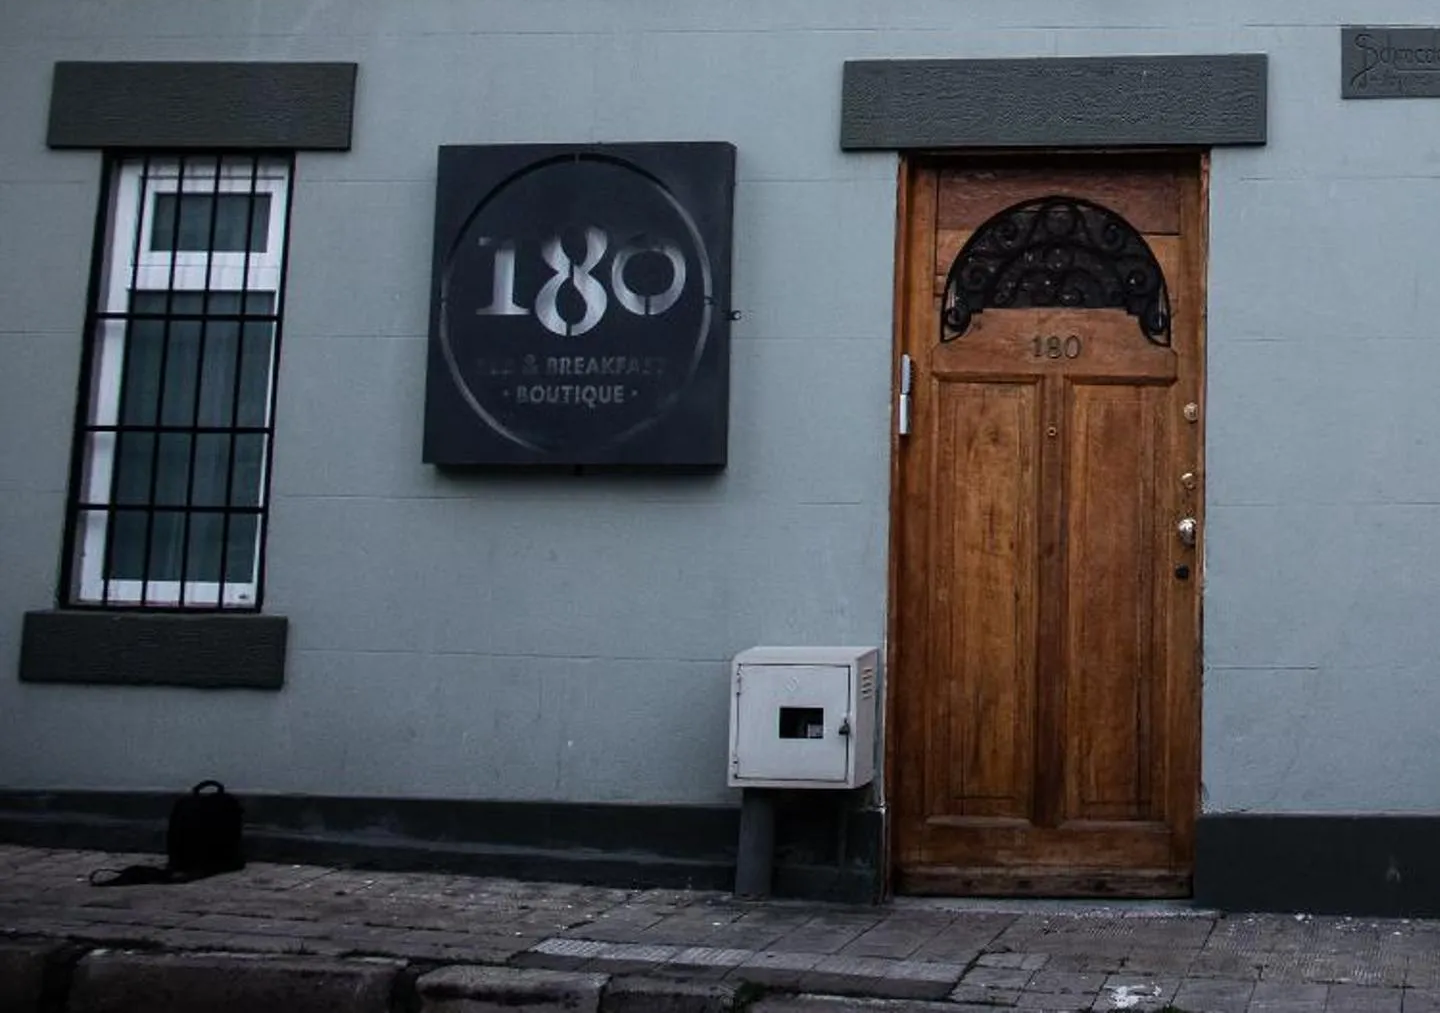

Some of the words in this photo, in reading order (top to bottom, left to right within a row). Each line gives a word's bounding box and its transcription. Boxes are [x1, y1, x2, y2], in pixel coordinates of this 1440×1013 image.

[476, 225, 687, 337] 180
[1032, 335, 1081, 360] 180
[516, 384, 625, 408] BOUTIQUE
